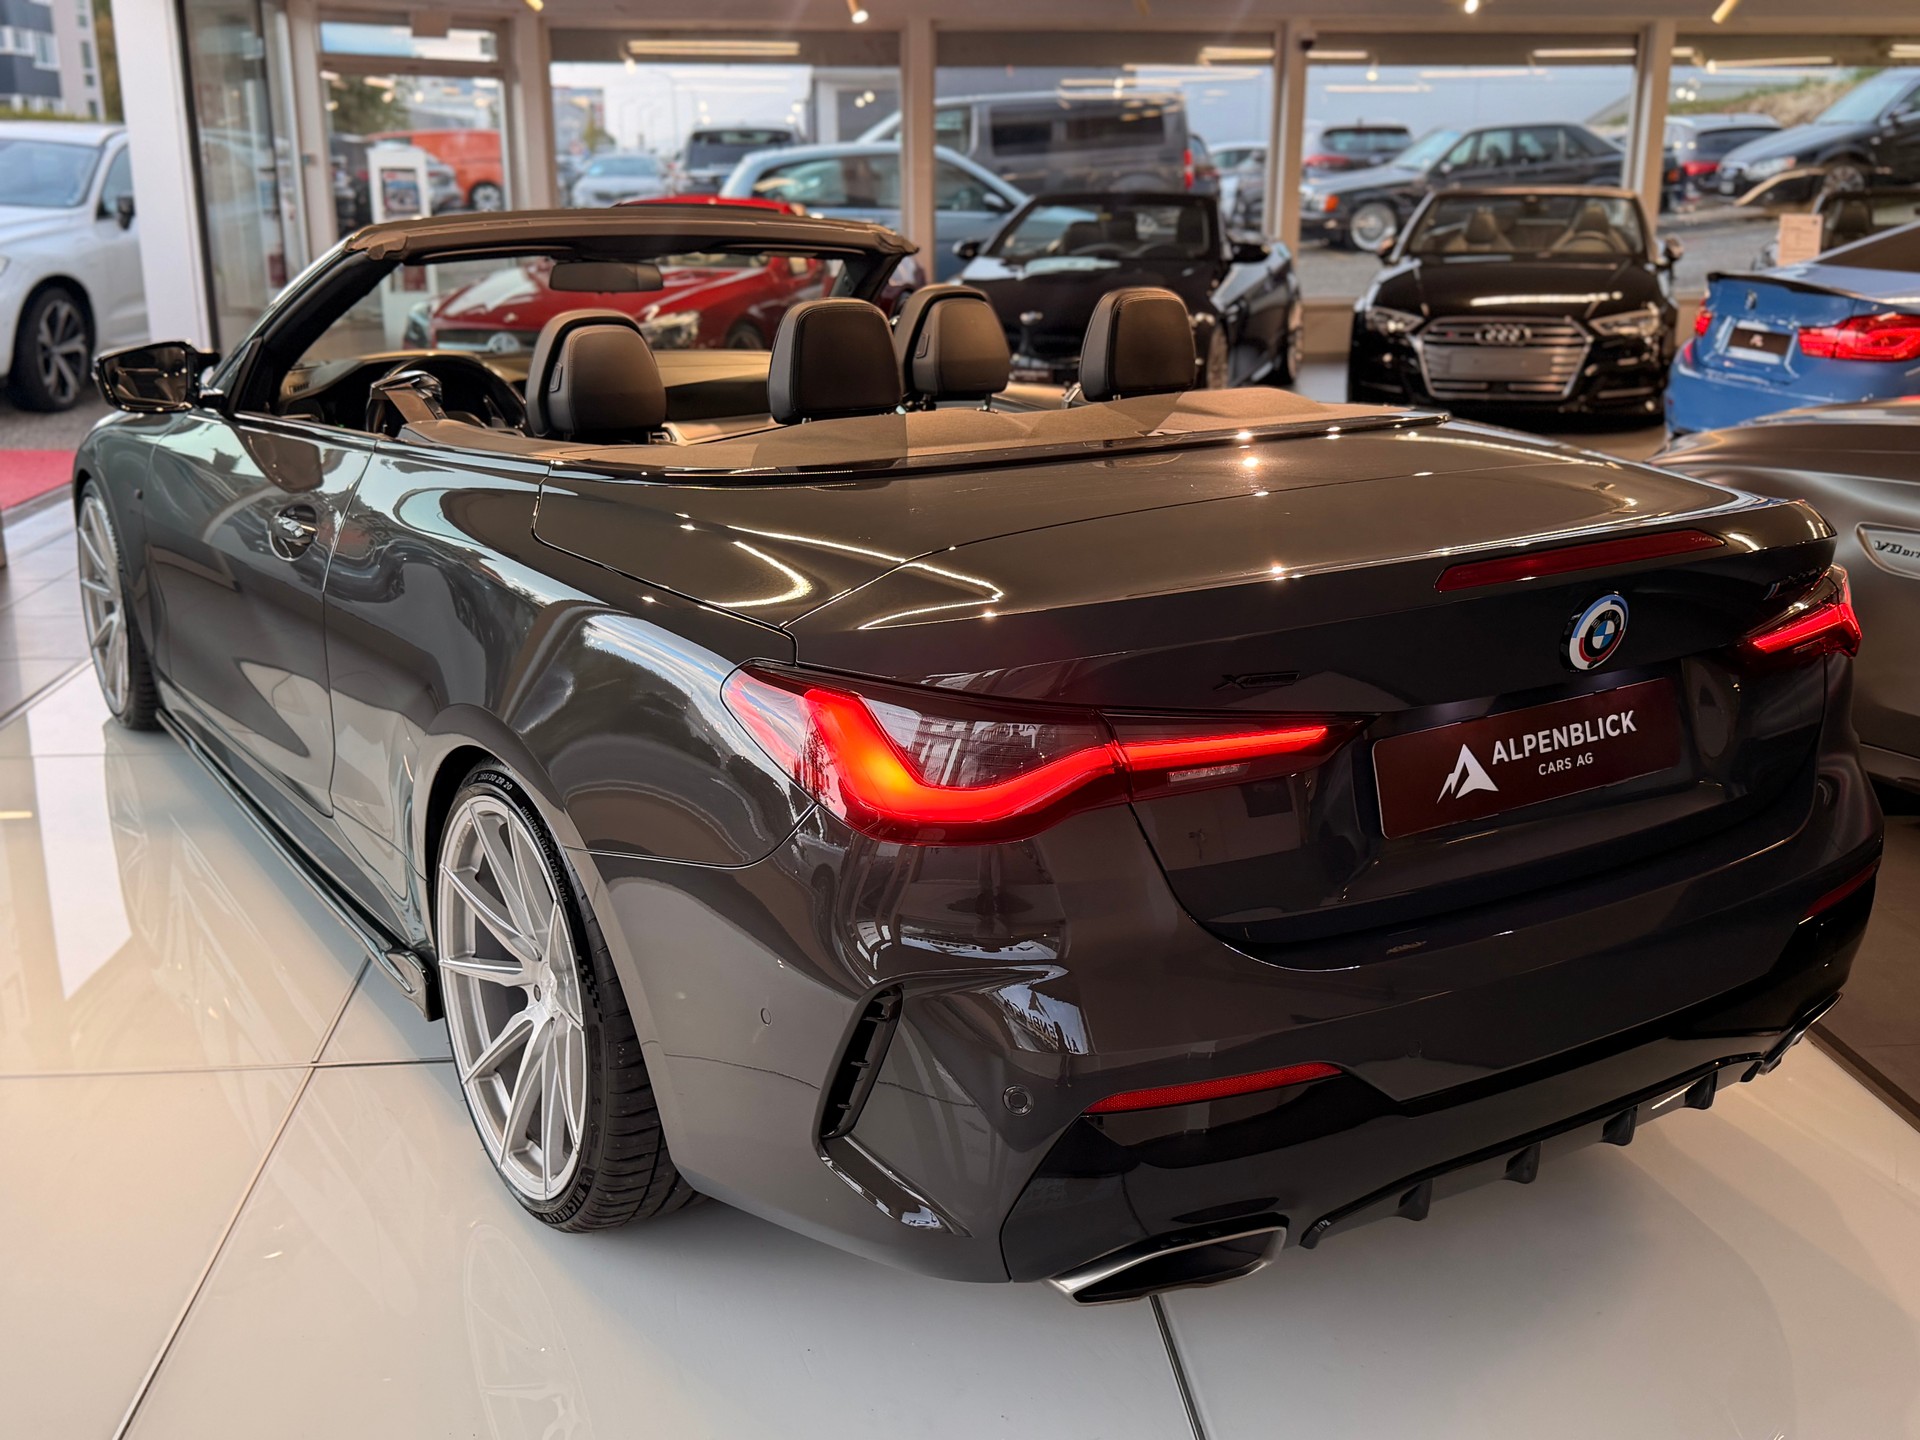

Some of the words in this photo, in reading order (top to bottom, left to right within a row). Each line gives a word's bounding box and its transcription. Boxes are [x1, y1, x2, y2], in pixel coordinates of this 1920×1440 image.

[1591, 610, 1621, 628] BMW
[1491, 710, 1637, 765] ALPENBLICK
[1538, 757, 1572, 776] CARS
[1576, 752, 1594, 767] AG
[495, 776, 506, 786] ZR
[503, 781, 513, 791] 20
[542, 1187, 587, 1223] MICHELIN
